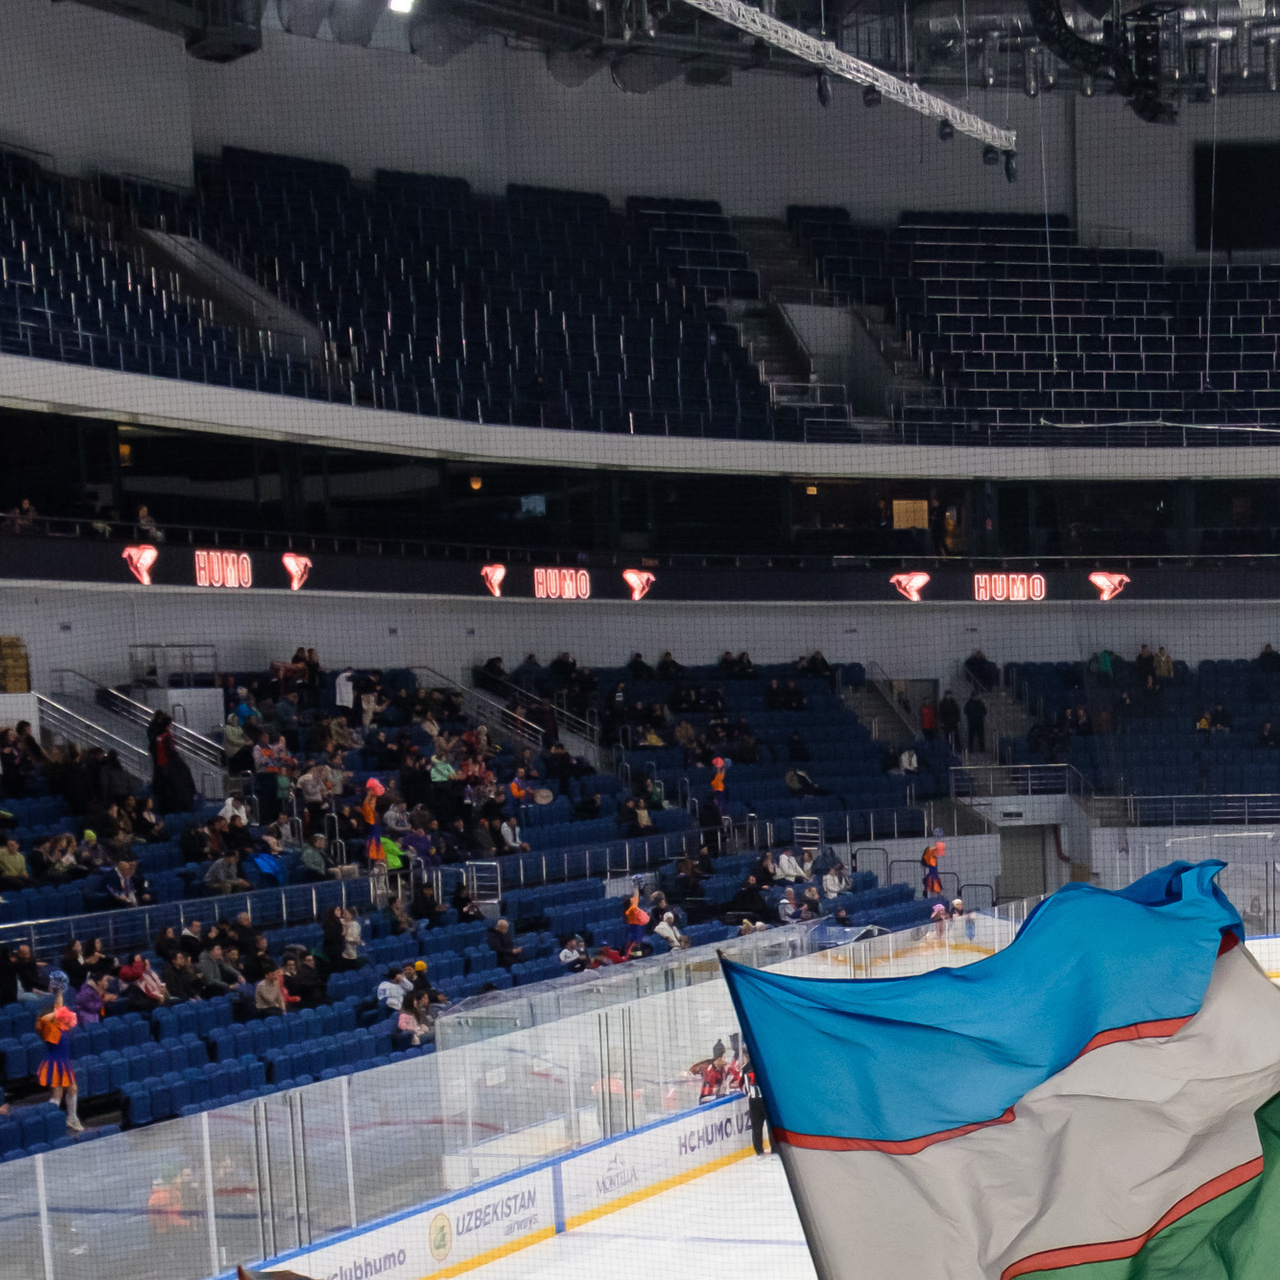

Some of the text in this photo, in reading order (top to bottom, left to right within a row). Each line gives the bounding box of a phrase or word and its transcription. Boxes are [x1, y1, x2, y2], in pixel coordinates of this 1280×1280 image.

[194, 549, 253, 588] HUMO
[533, 567, 591, 599] HUMO
[974, 573, 1046, 601] HUMO
[678, 1110, 752, 1156] HCHUMO.UZ
[455, 1188, 537, 1236] UZBEKISTAN
[503, 1213, 539, 1238] airways
